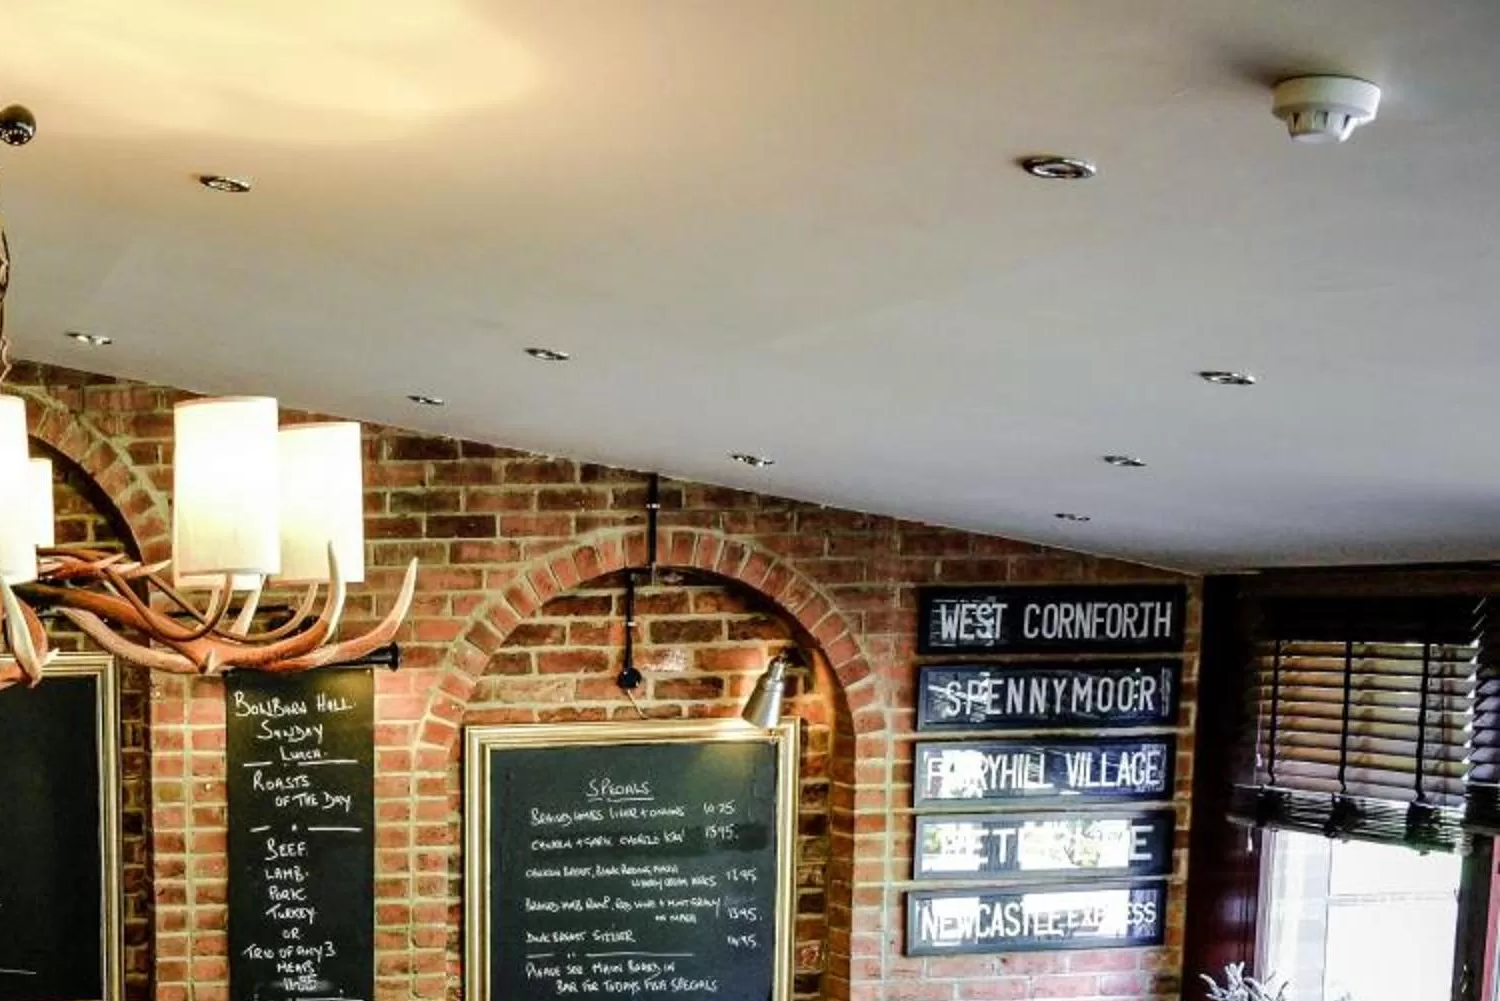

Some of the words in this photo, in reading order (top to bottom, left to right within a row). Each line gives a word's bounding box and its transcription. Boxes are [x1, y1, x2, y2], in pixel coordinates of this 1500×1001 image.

[940, 602, 1008, 641] WEST
[1023, 601, 1172, 639] CORNFORTH
[945, 676, 1157, 717] SPENNYMOOR
[257, 720, 323, 744] SUNDAY
[253, 769, 310, 791] ROASTS
[1066, 751, 1162, 789] VILLAGE
[275, 795, 290, 808] OF
[292, 792, 319, 808] THE
[322, 791, 351, 813] DAY
[269, 885, 307, 901] PORK
[265, 903, 317, 924] TURKEY
[279, 946, 294, 959] OF
[324, 941, 336, 957] 3
